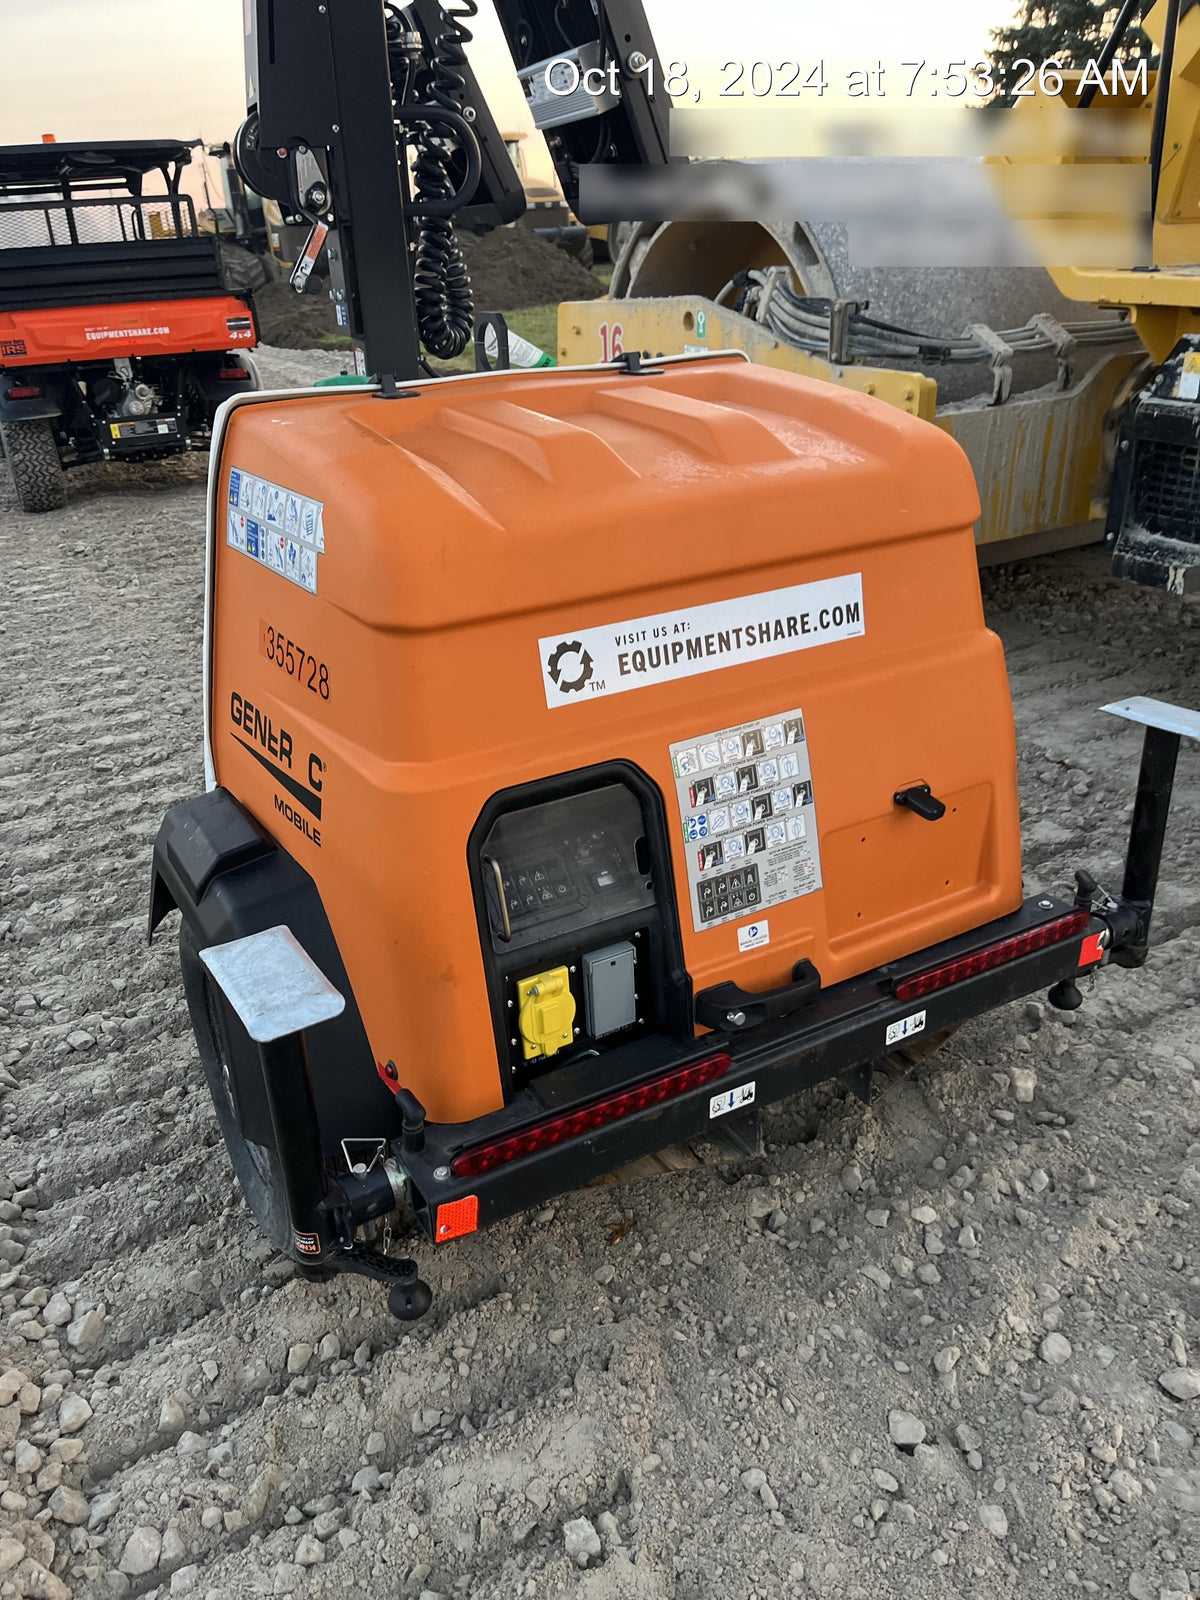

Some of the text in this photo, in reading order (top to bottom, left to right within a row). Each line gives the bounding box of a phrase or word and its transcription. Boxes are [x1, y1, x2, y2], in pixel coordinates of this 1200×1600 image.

[86, 326, 170, 340] EQUIPMENTSHARE.COM
[599, 322, 624, 364] 16
[614, 621, 691, 647] VISIT US AT:
[617, 602, 861, 677] EQUIPMENTSHARE.COM
[266, 625, 330, 701] 355728
[589, 679, 606, 693] TM
[230, 691, 323, 793] GENERC
[274, 793, 322, 848] MOBILE
